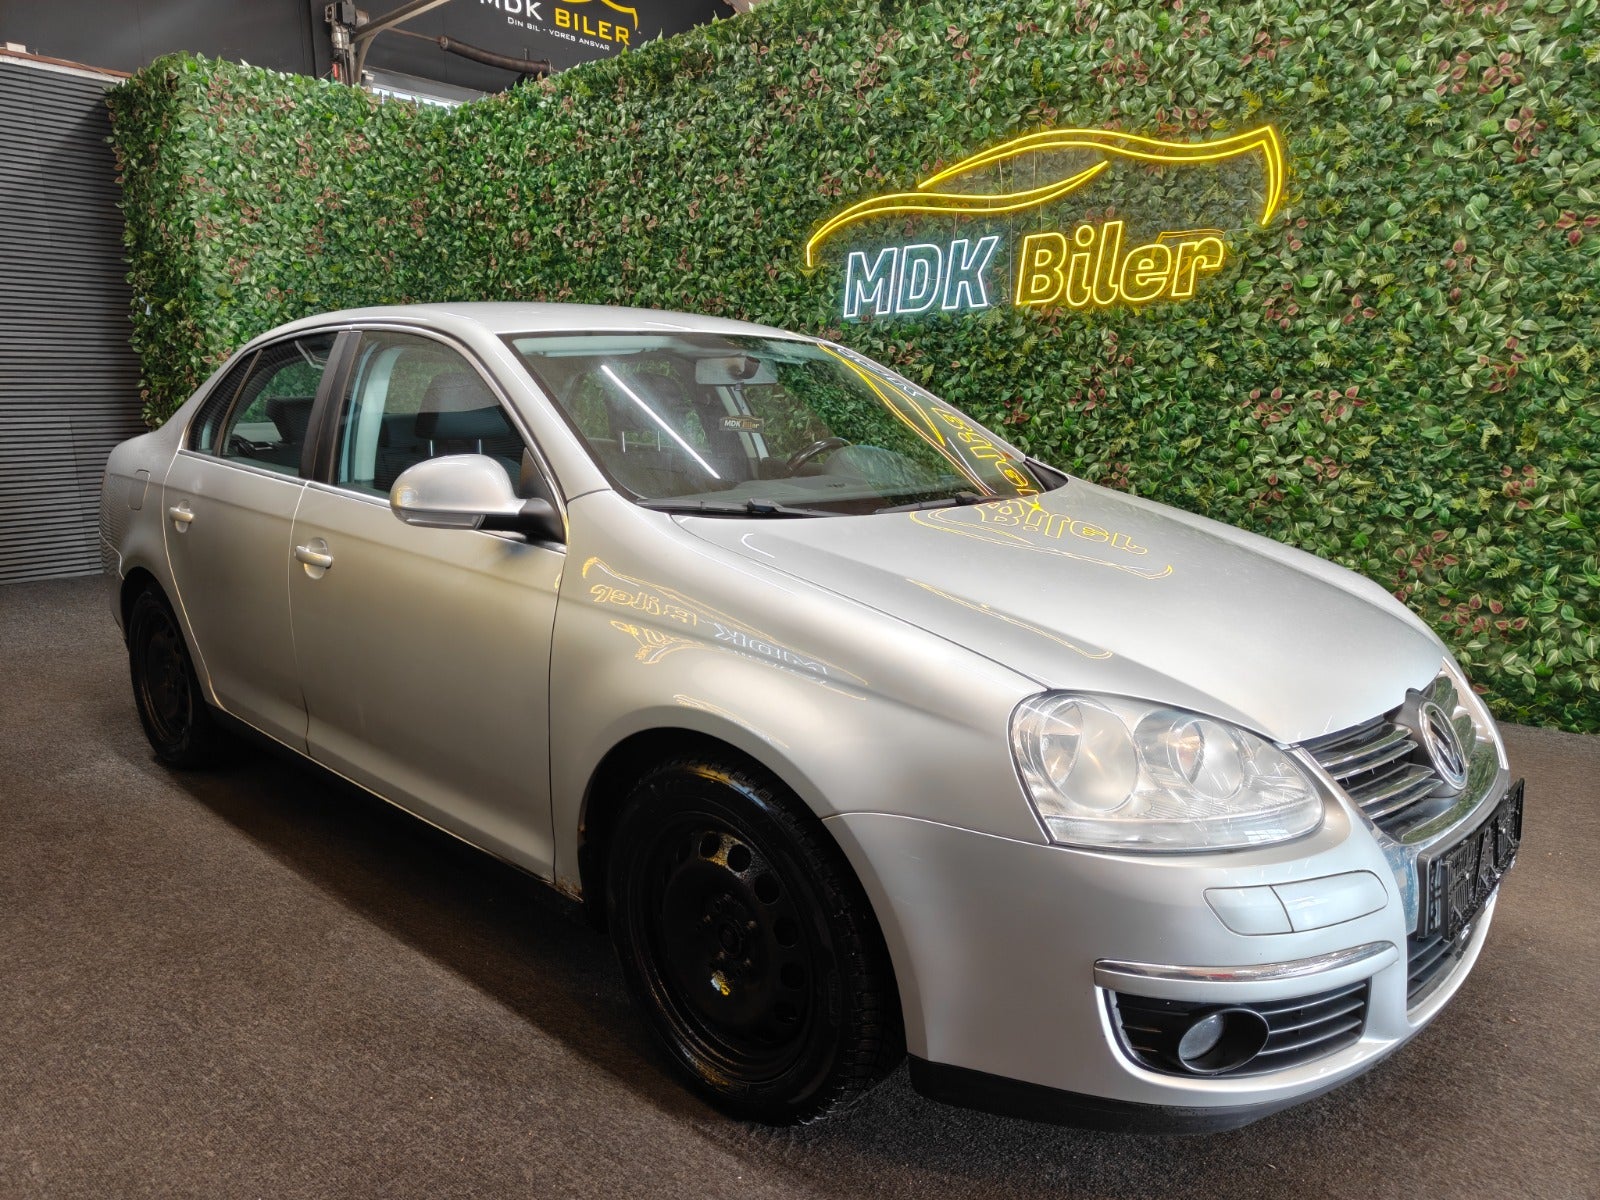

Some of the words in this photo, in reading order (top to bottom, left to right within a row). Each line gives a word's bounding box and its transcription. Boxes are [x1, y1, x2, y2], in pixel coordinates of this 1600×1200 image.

[507, 17, 524, 27] DIN
[526, 23, 541, 32] BIL
[549, 29, 576, 42] VORES
[579, 37, 610, 51] ANSVAR
[555, 8, 630, 45] BILER
[843, 235, 999, 318] MDK
[1015, 221, 1224, 306] Biler
[724, 419, 741, 428] MDK
